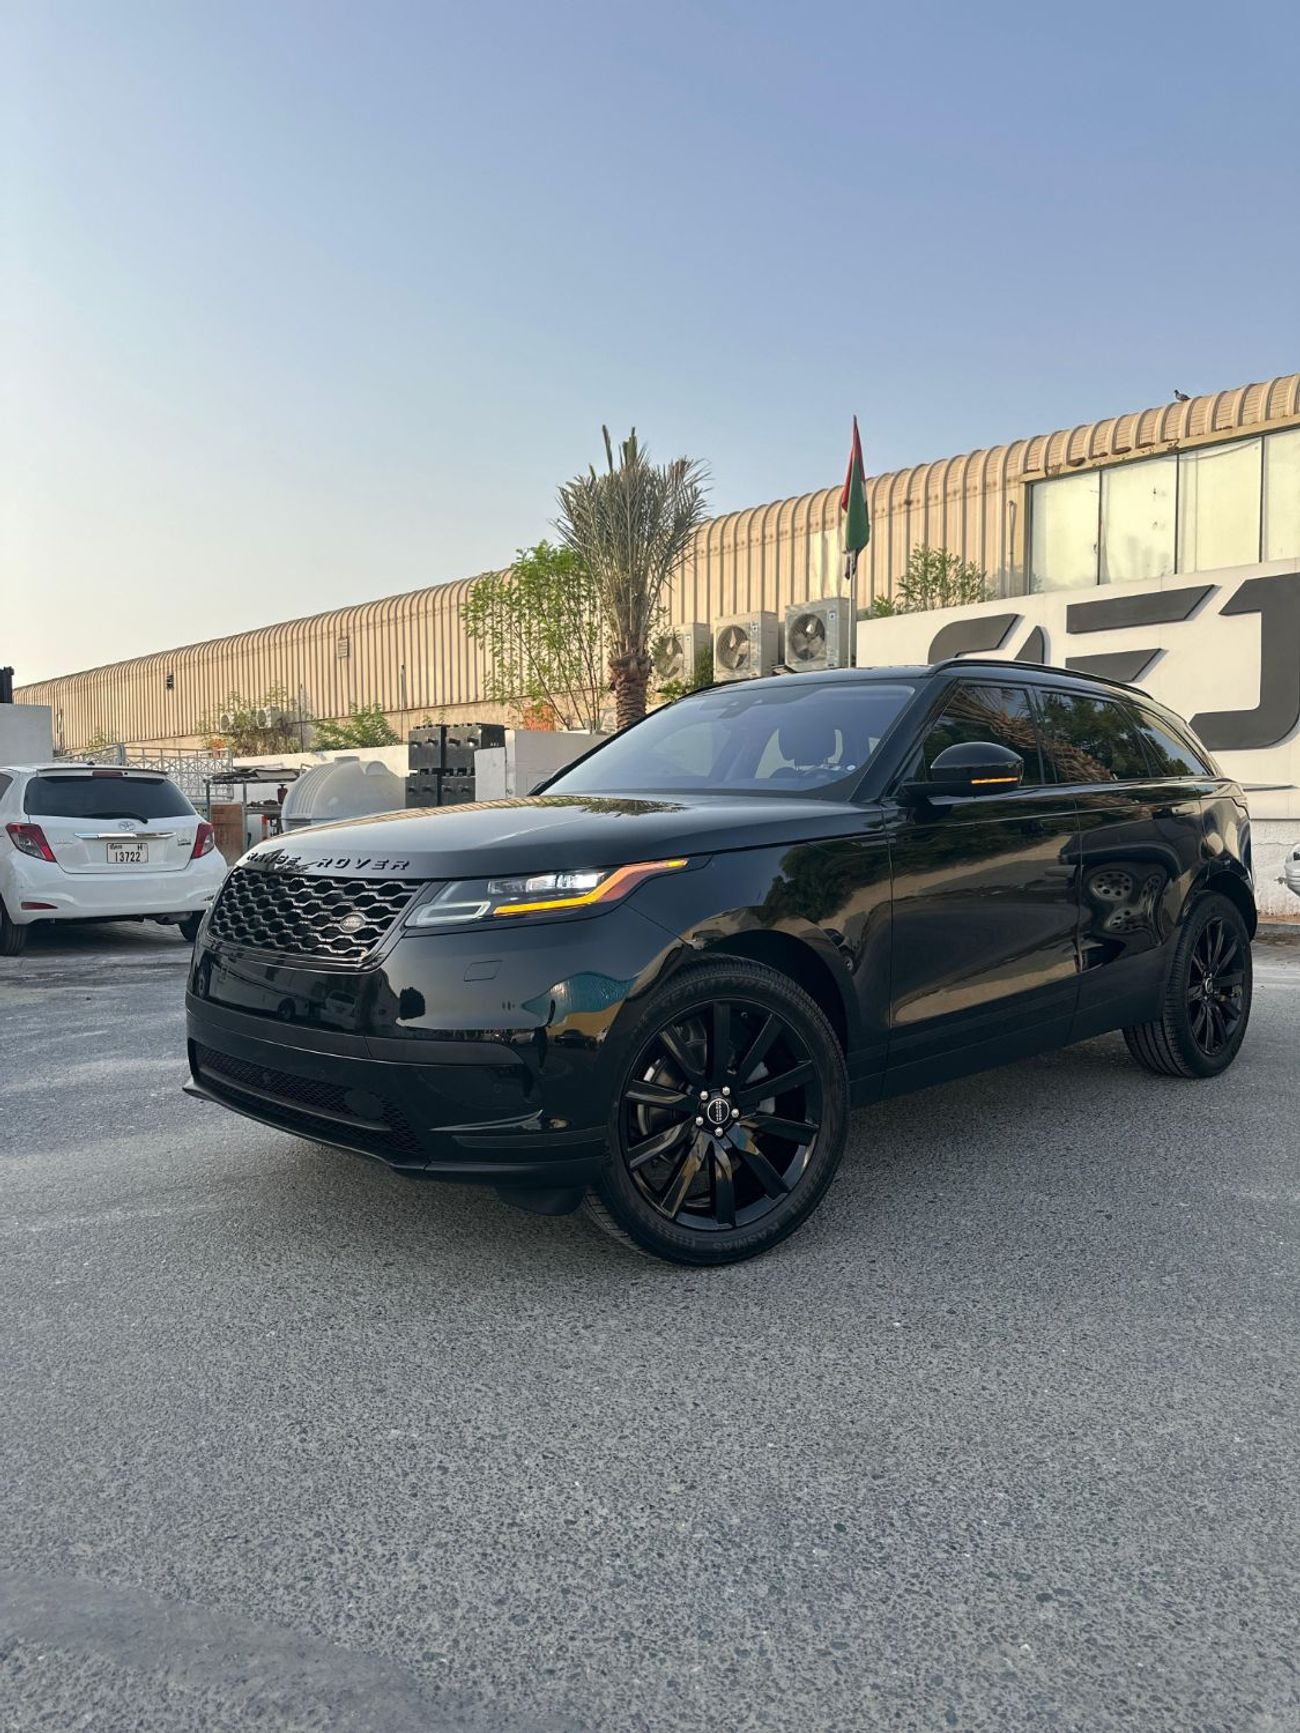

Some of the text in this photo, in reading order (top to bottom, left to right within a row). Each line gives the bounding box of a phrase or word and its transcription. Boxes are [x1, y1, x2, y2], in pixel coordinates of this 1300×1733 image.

[115, 851, 141, 862] 13722
[246, 852, 410, 871] RANGE ROVER
